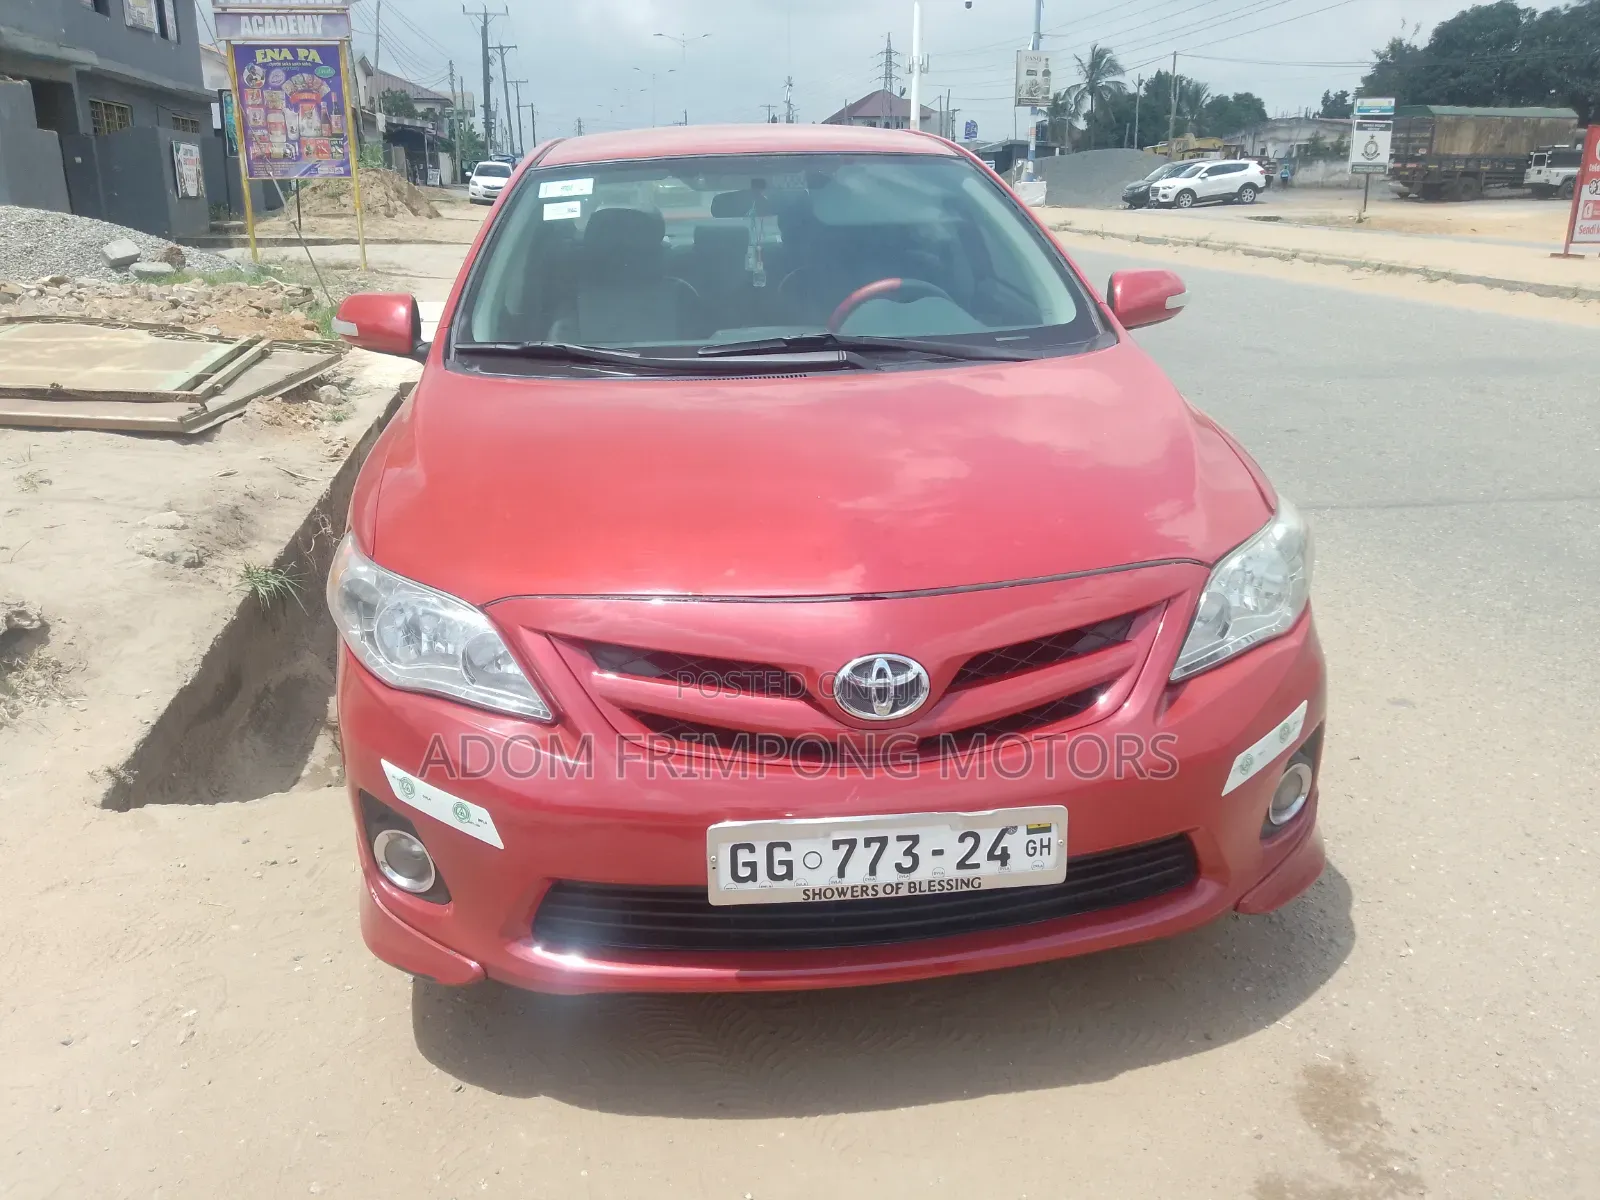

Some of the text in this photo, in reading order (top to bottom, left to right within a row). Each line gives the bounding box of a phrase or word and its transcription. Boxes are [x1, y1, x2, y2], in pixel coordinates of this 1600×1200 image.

[240, 15, 323, 35] ACADEMY
[255, 48, 323, 64] ENA PA
[730, 842, 793, 883] GG
[1025, 837, 1051, 857] GH
[802, 876, 982, 901] SHOWERS OF BLESSING
